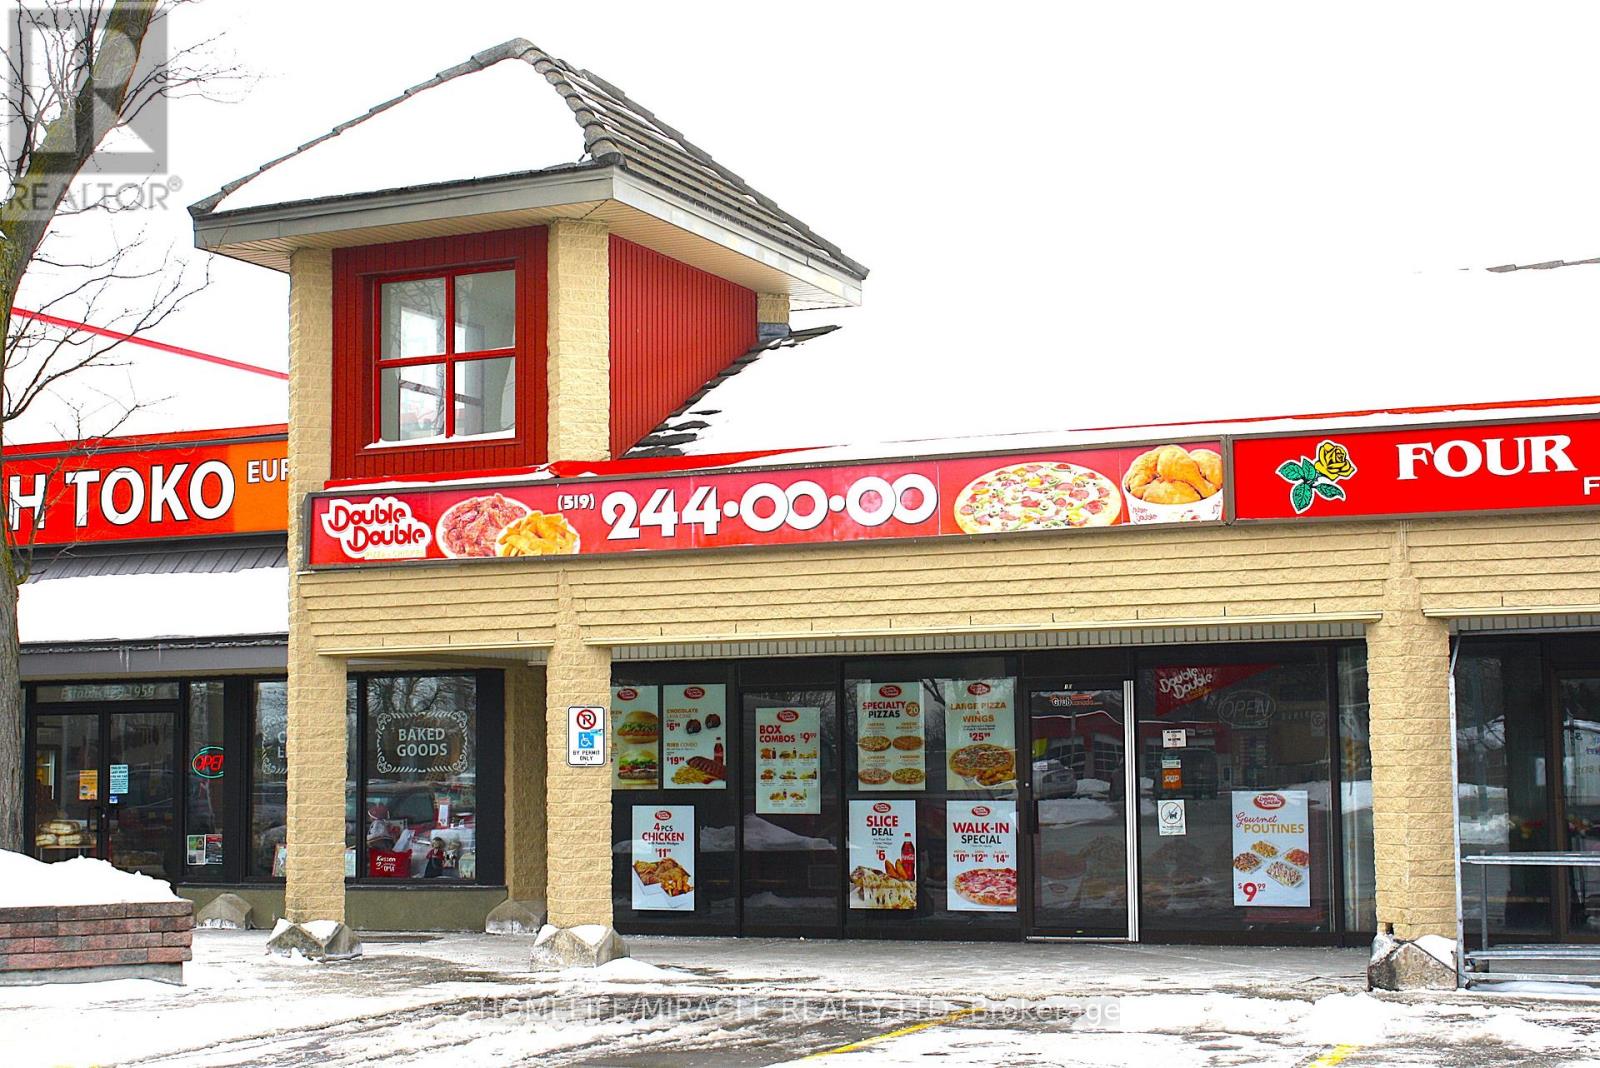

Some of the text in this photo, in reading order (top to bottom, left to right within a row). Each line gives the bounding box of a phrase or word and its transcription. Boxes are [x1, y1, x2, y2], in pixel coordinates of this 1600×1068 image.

[1396, 435, 1579, 481] FOUR
[65, 460, 235, 527] TOKO
[557, 492, 595, 512] (519)
[328, 503, 406, 531] Double
[346, 524, 425, 552] Double
[1159, 667, 1198, 694] Double
[1173, 673, 1213, 699] Double
[862, 701, 906, 710] SPECIALTY
[951, 702, 977, 710] LARGE
[1221, 699, 1271, 720] OPEN
[868, 710, 900, 718] PIZZAS
[398, 727, 446, 741] BAKED
[760, 725, 781, 734] BOX
[759, 735, 796, 743] COMBOS
[396, 743, 448, 757] GOODS
[866, 815, 899, 827] SLICE
[1235, 811, 1278, 828] Gourmet
[654, 822, 660, 831] 4
[871, 828, 894, 836] DEAL
[953, 822, 1010, 833] WALK-IN
[1244, 823, 1305, 834] POUTINES
[642, 832, 685, 841] CHICKEN
[961, 835, 1002, 844] SPECIAL
